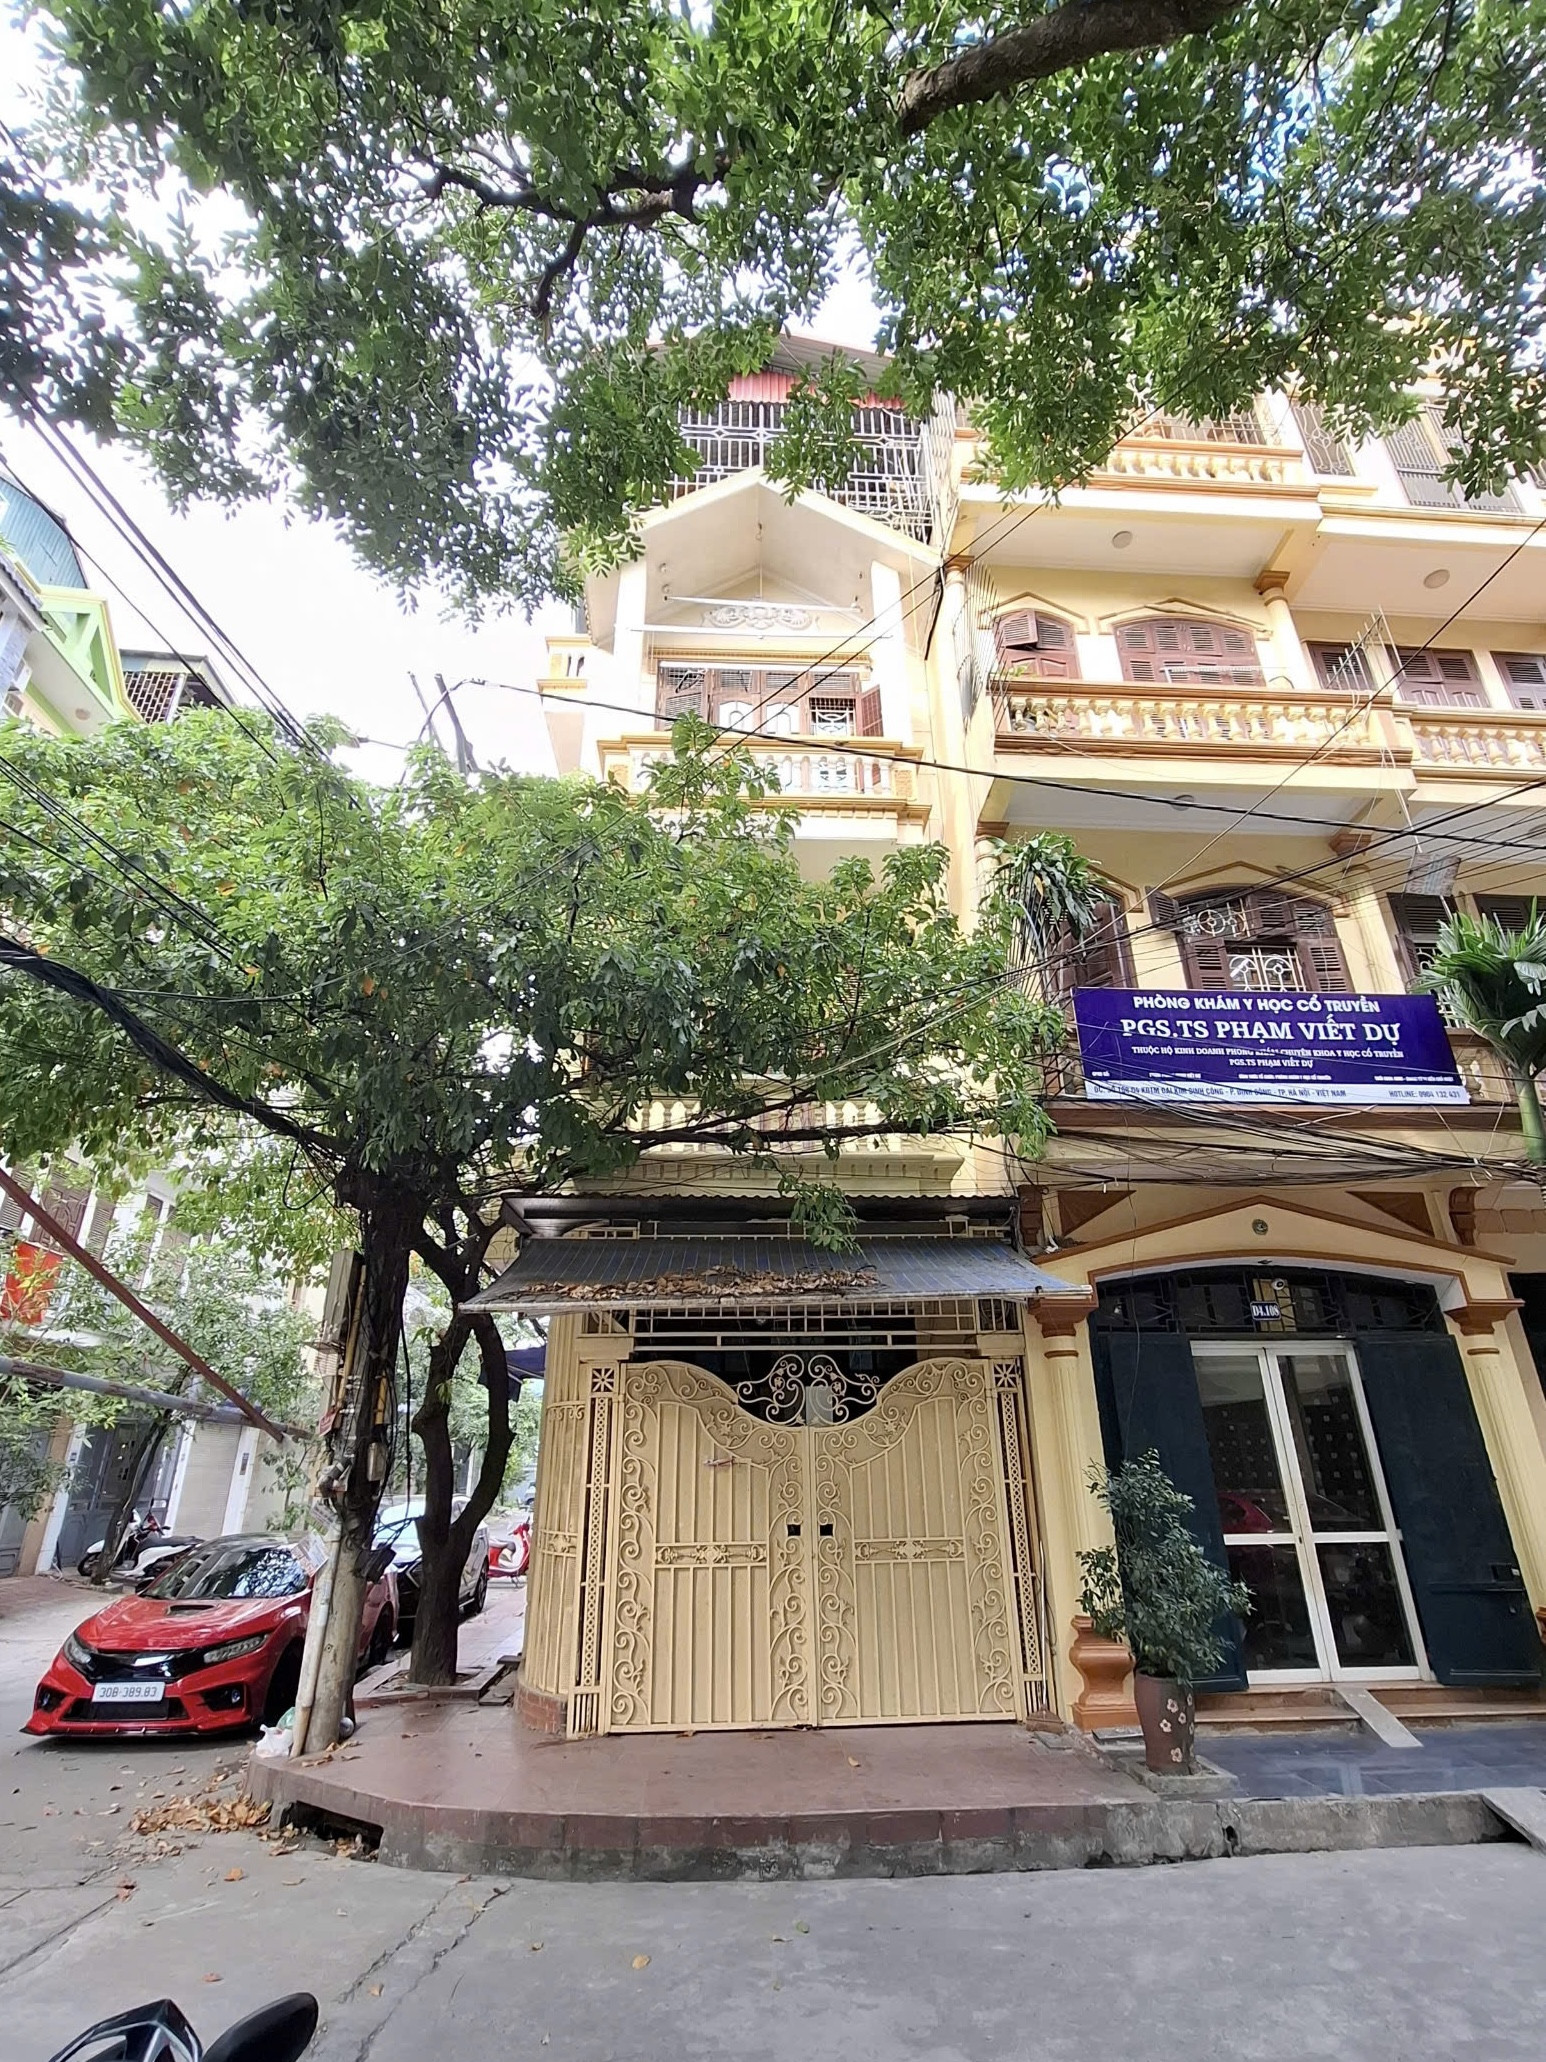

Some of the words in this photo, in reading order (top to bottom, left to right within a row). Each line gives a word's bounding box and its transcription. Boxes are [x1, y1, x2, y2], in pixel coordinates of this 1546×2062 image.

[1133, 994, 1190, 1009] PHÒNG
[1194, 995, 1241, 1010] KHÁM
[1242, 998, 1253, 1010] Y
[1257, 999, 1293, 1014] HỌC
[1296, 994, 1321, 1011] CỔ
[1324, 995, 1381, 1012] TRUYỀN
[1122, 1019, 1209, 1038] PGS.TS
[1214, 1021, 1295, 1044] PHẠM
[1297, 1013, 1356, 1040] VIẾT
[1361, 1022, 1401, 1046] DỰ
[1131, 1045, 1159, 1056] THUỘC
[1160, 1045, 1172, 1056] HỘ
[1174, 1047, 1195, 1055] KINH
[1196, 1047, 1225, 1055] DOANH
[1312, 1049, 1335, 1057] KHOA
[1335, 1049, 1343, 1057] Y
[1343, 1049, 1360, 1058] HỌC
[1361, 1047, 1373, 1057] CỔ
[1374, 1048, 1404, 1058] TRUYỀN
[1229, 1058, 1256, 1066] PGS.TS
[1257, 1059, 1281, 1068] PHẠM
[1282, 1057, 1300, 1067] VIẾT
[1301, 1059, 1313, 1069] DỰ
[1331, 1090, 1347, 1098] NAM
